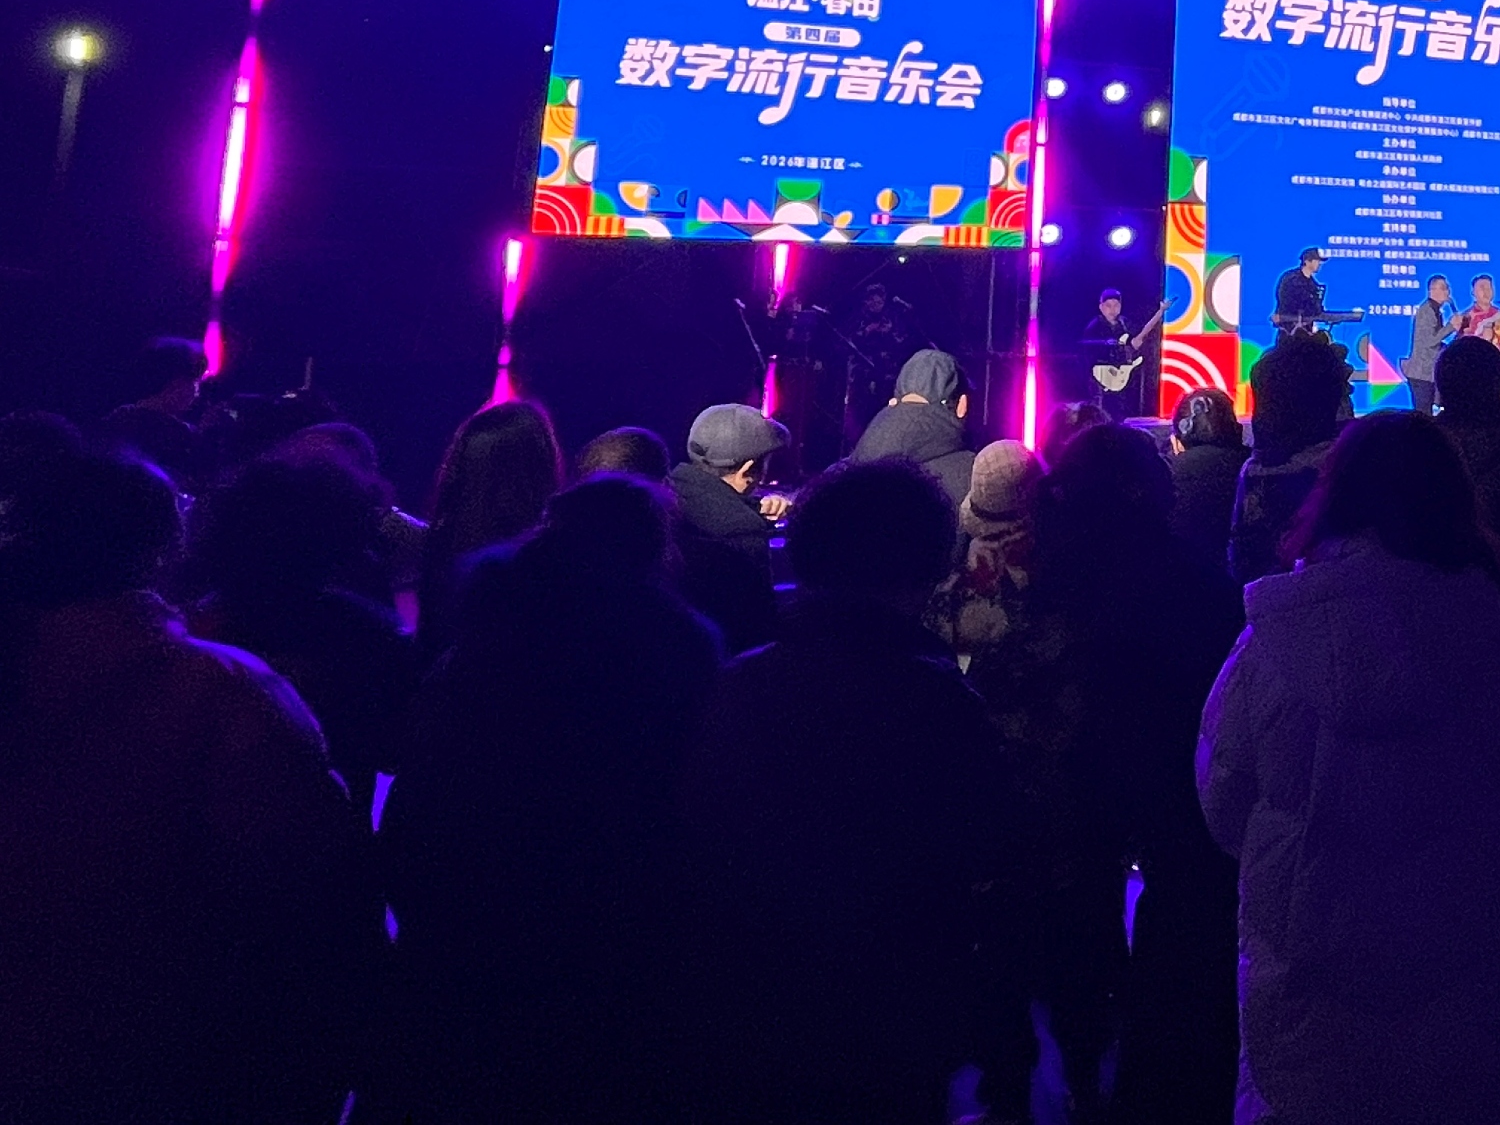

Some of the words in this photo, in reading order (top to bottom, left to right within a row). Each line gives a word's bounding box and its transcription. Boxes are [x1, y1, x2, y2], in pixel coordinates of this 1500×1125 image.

[785, 25, 841, 44] 第四届
[615, 36, 984, 126] 数字流行音乐会
